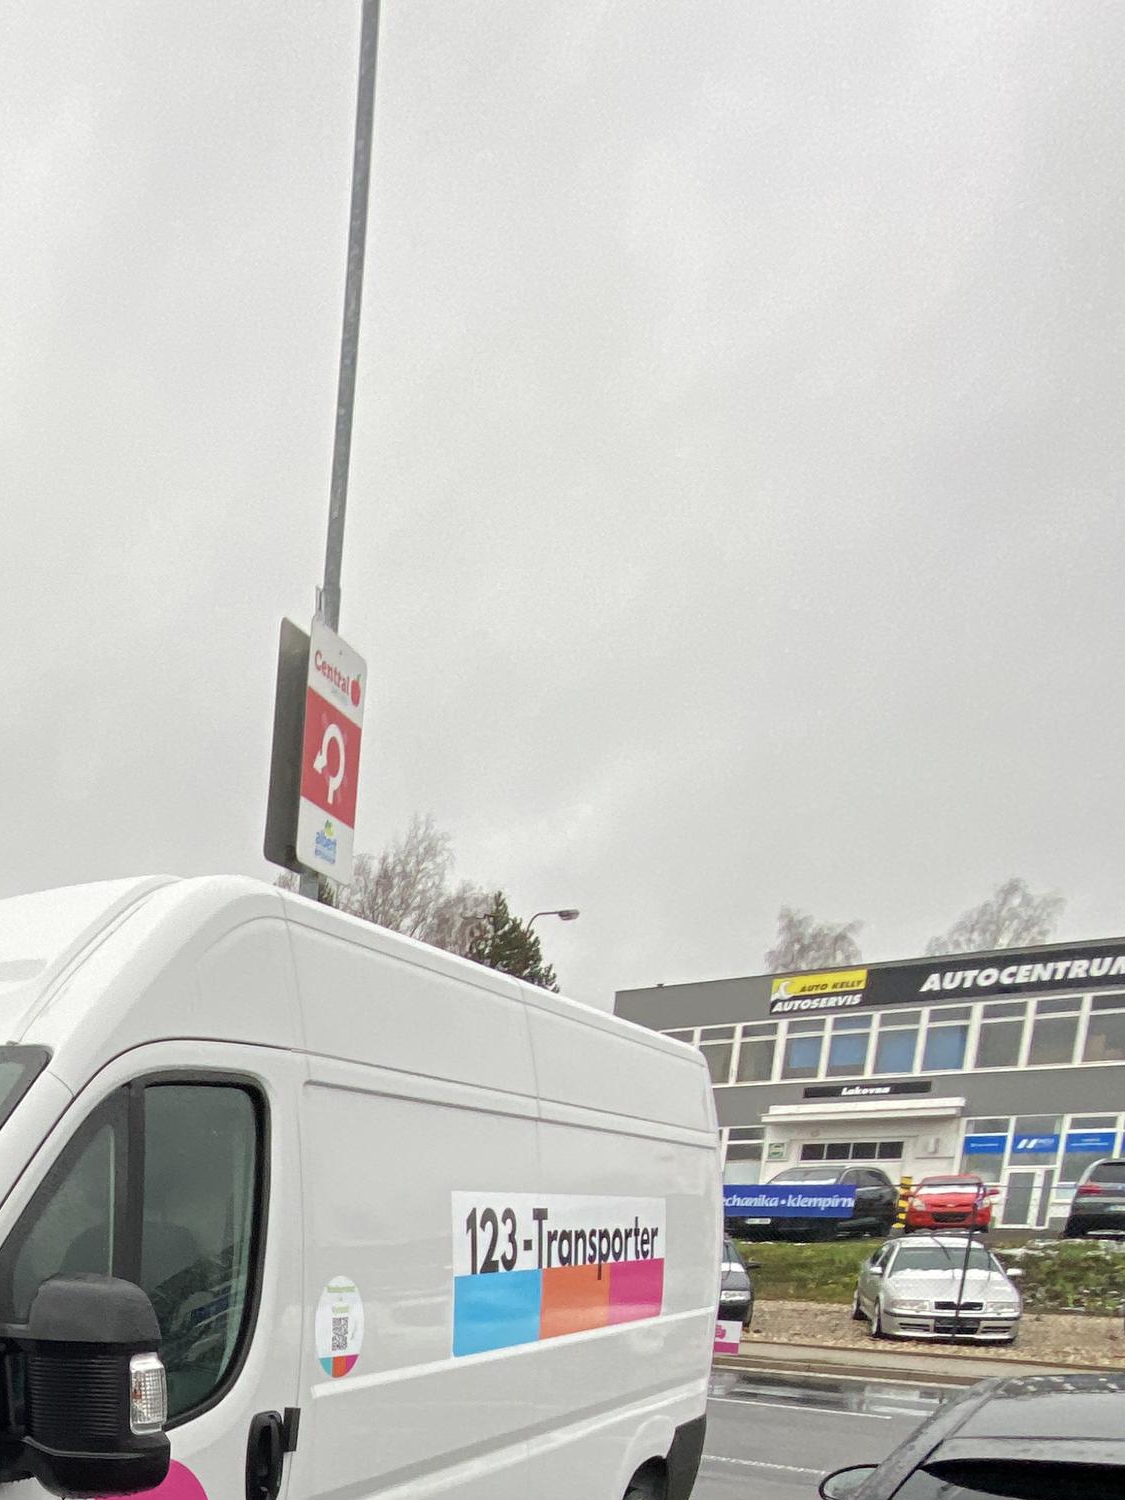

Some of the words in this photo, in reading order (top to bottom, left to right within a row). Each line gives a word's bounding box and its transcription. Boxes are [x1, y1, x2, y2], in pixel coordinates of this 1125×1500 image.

[314, 649, 350, 696] Central
[799, 983, 828, 993] AUTO
[832, 980, 864, 990] KELLY
[771, 994, 862, 1013] AUTOSERVIS
[723, 1194, 779, 1207] chanika
[465, 1207, 659, 1281] 123-Transporter
